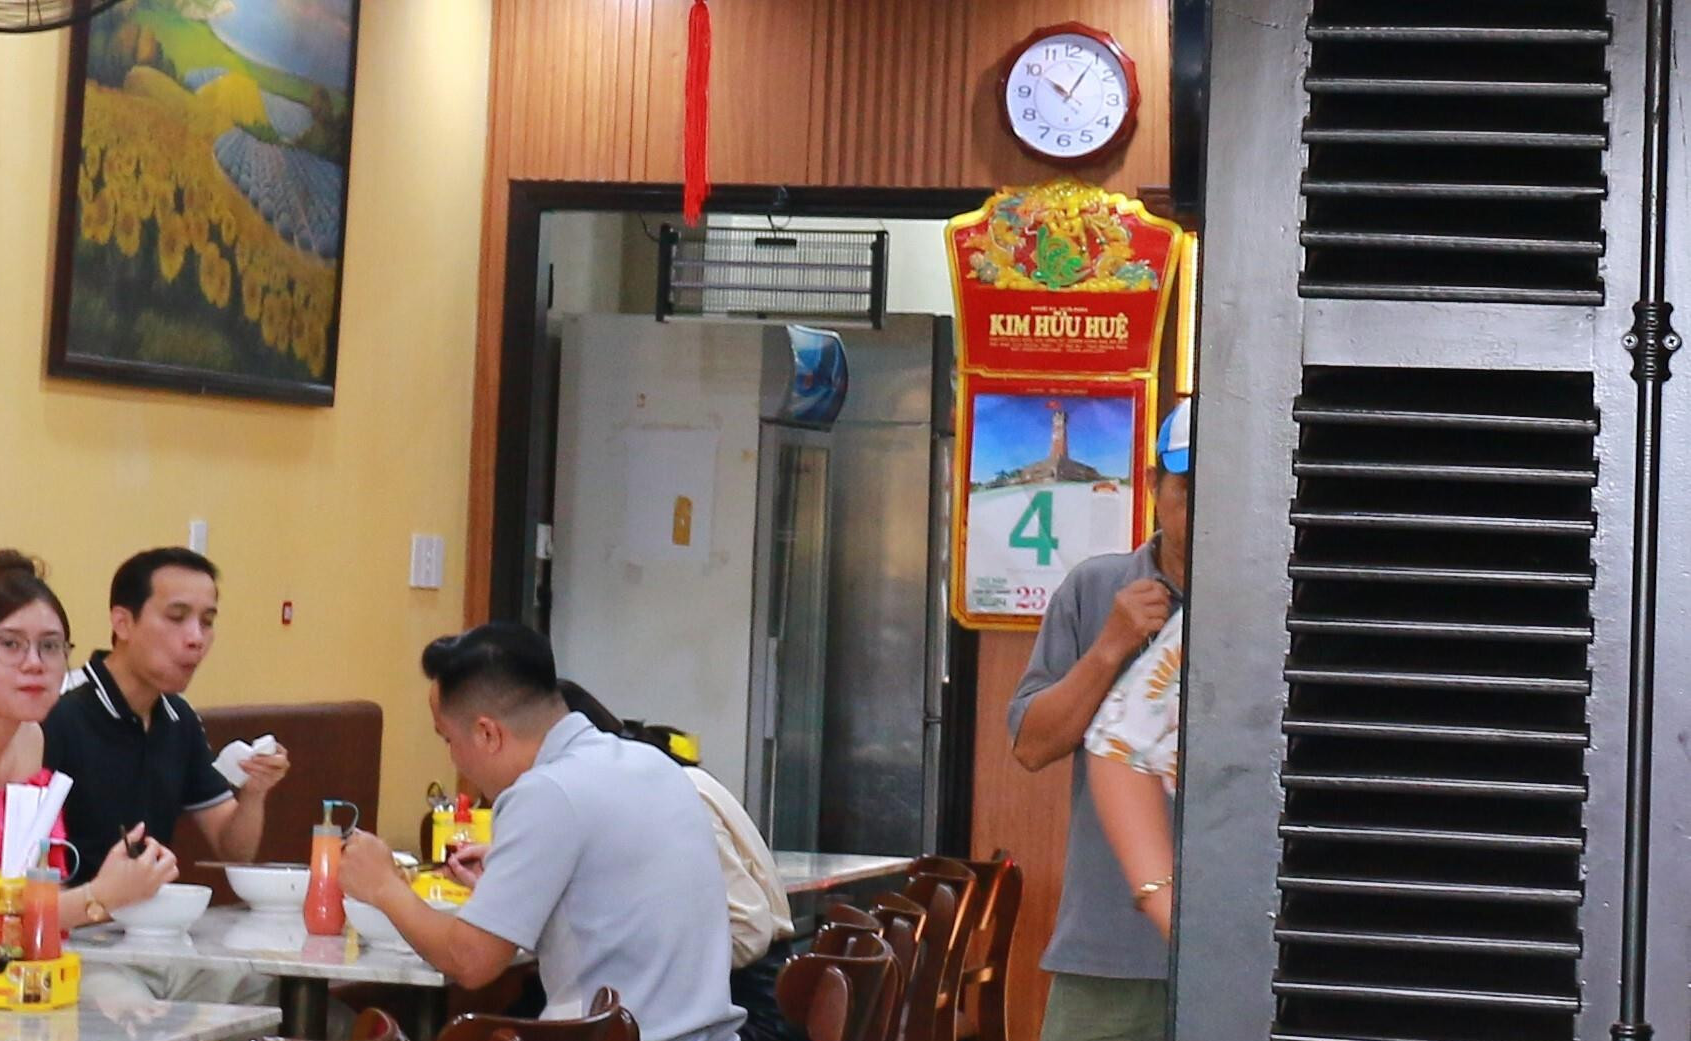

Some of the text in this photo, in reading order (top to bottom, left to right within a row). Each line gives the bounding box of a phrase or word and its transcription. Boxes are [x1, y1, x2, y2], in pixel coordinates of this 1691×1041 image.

[1046, 48, 1058, 62] 11
[1064, 44, 1083, 58] 12
[1025, 63, 1043, 77] 10
[1102, 70, 1117, 84] 2
[1017, 85, 1032, 99] 9
[1105, 93, 1120, 107] 3
[1022, 108, 1037, 122] 8
[1096, 115, 1111, 129] 4
[1037, 126, 1051, 140] 7
[1079, 130, 1094, 143] 5
[1057, 134, 1072, 148] 6
[989, 311, 1129, 340] KIM HỮU HUỆ
[1008, 490, 1059, 567] 4
